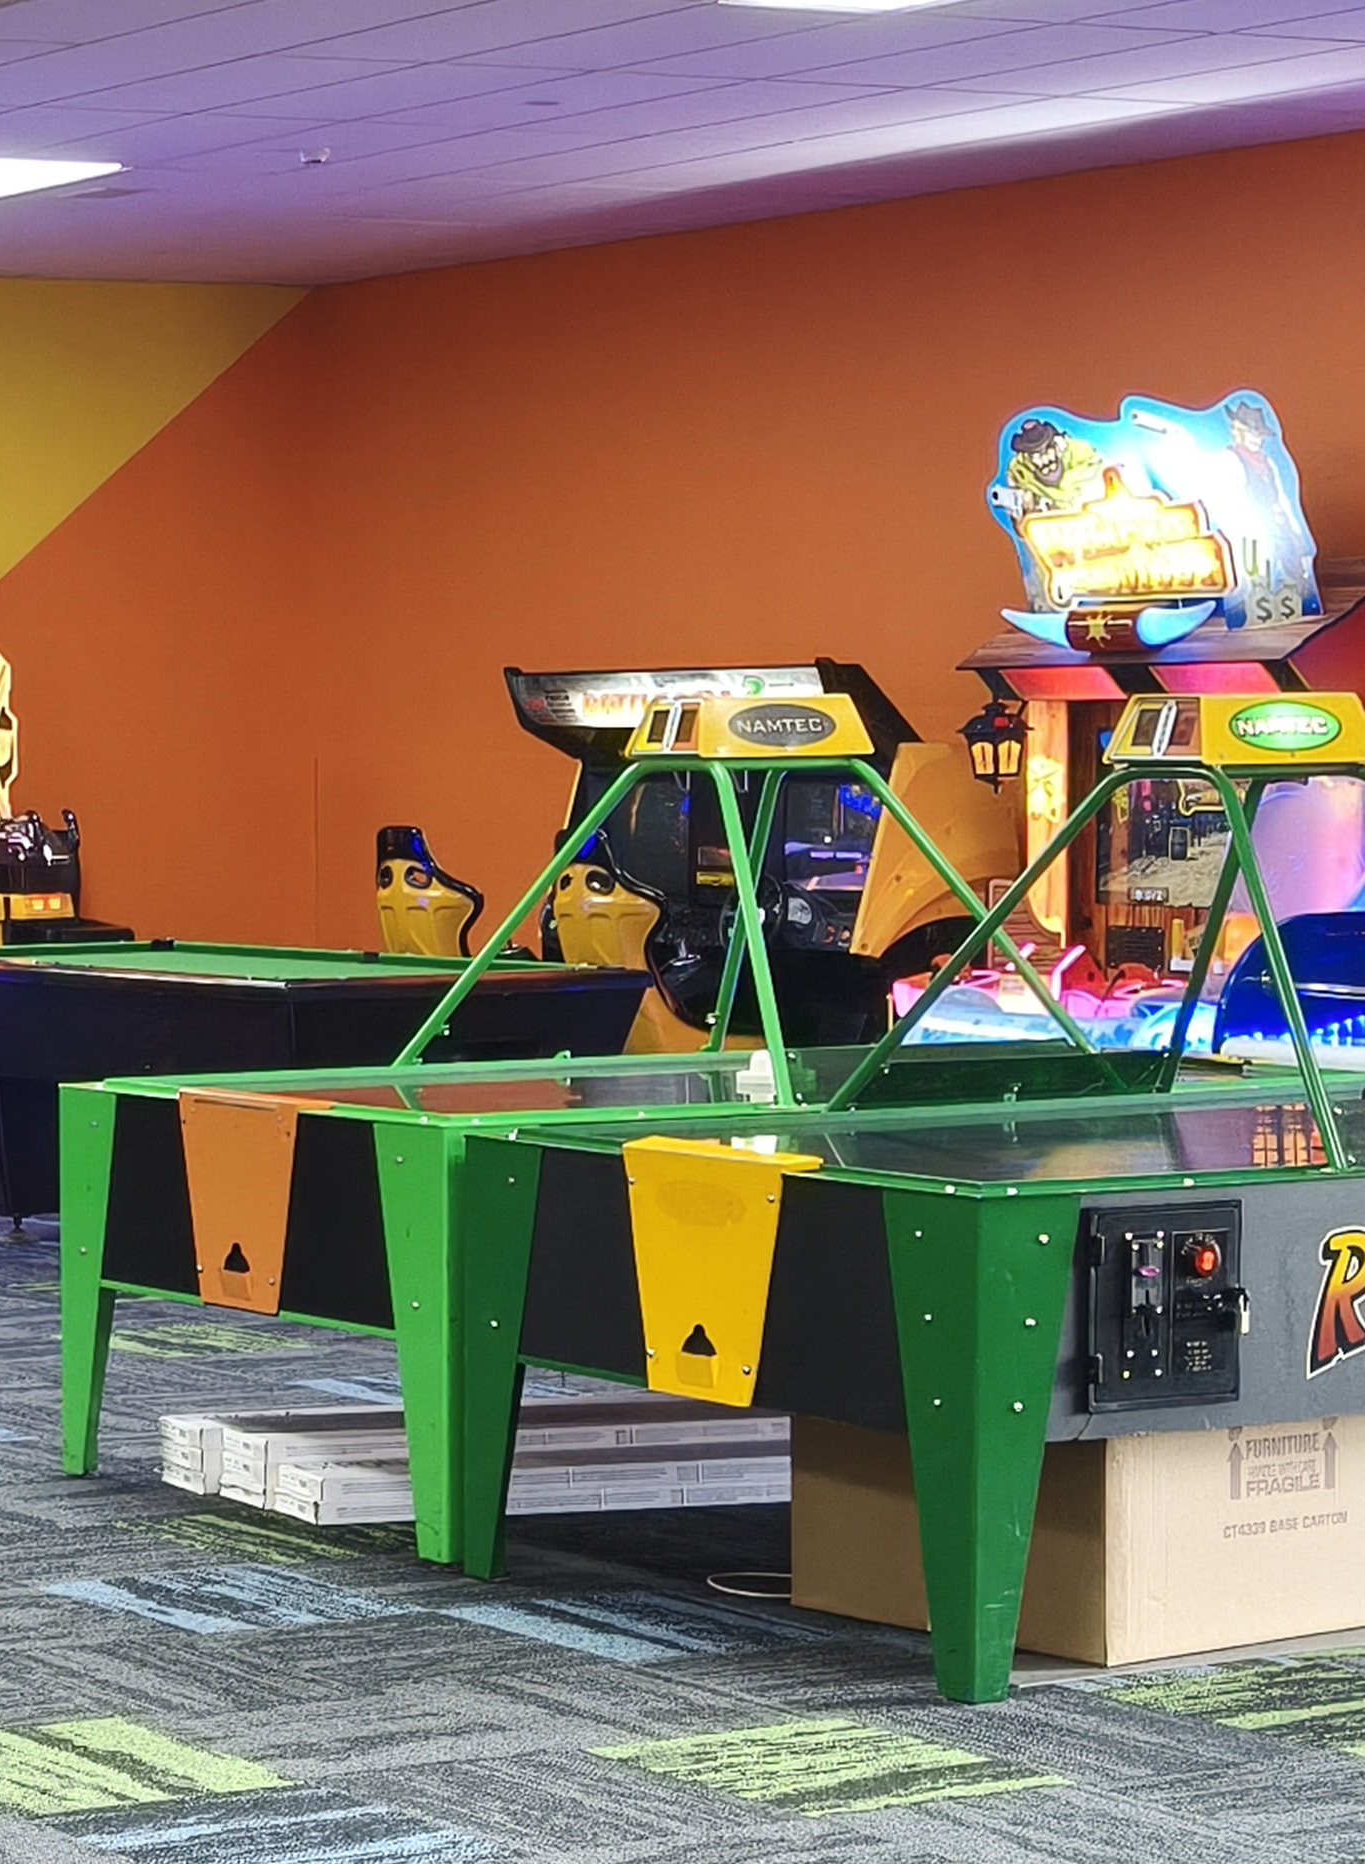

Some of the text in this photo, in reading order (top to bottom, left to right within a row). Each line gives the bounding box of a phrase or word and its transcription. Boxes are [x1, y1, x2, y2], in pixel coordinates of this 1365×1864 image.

[1245, 1432, 1320, 1460] FURNITURE
[1246, 1473, 1320, 1498] FRAGILE
[1269, 1517, 1299, 1533] BASE
[1302, 1510, 1348, 1529] CARTON
